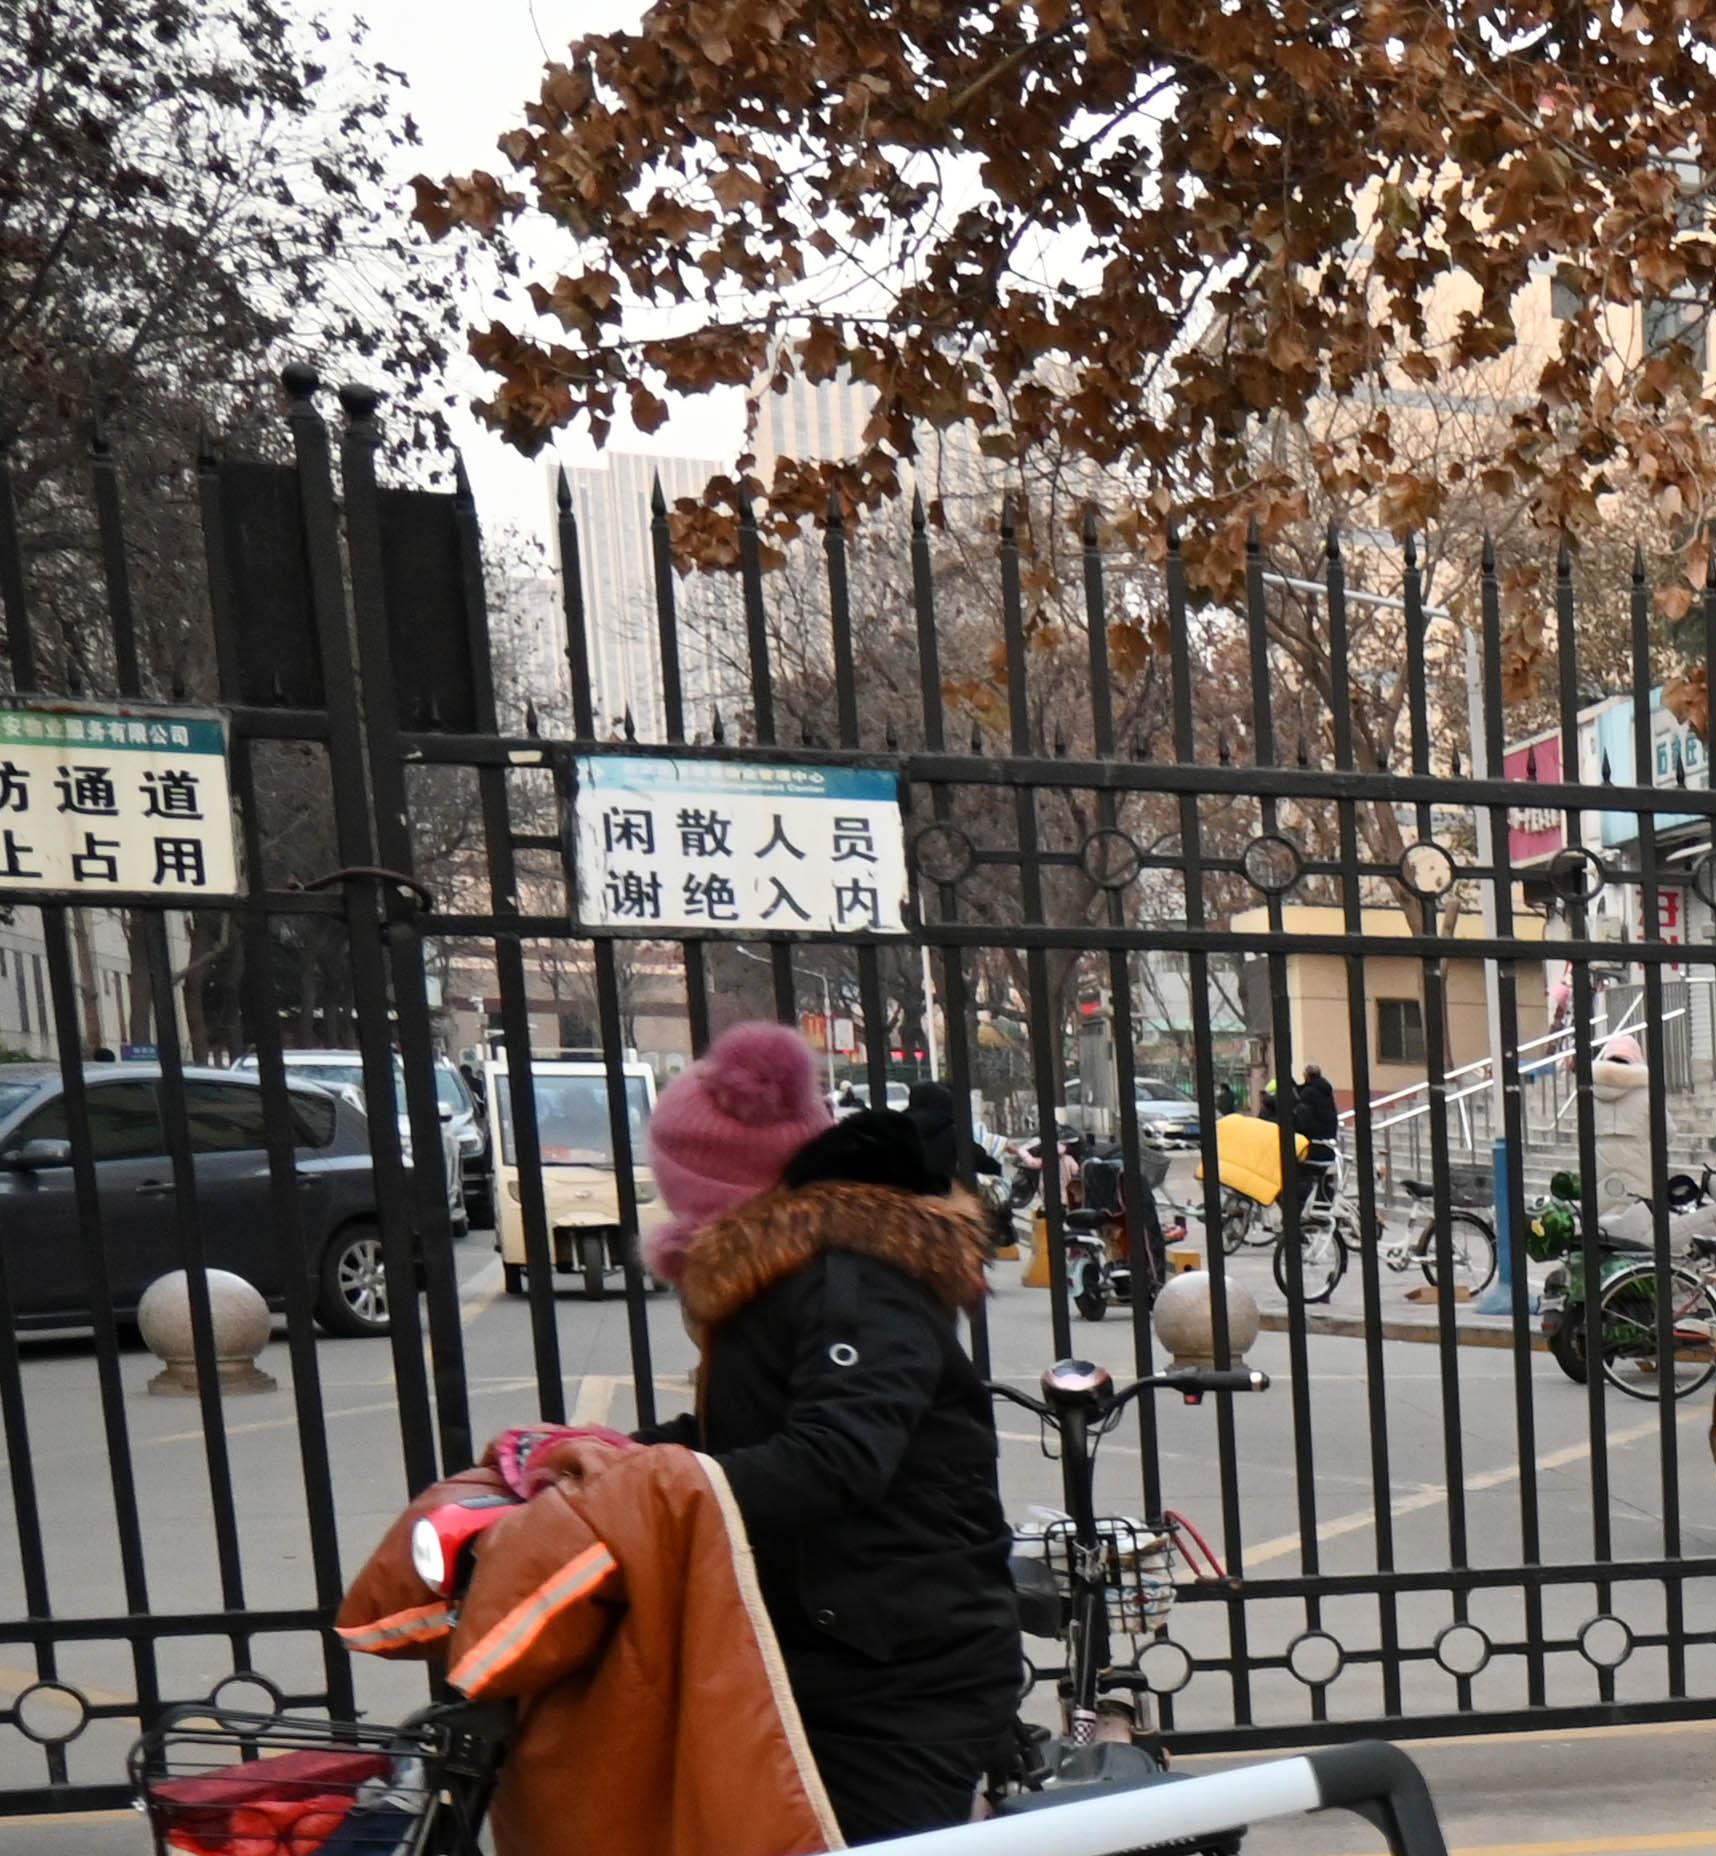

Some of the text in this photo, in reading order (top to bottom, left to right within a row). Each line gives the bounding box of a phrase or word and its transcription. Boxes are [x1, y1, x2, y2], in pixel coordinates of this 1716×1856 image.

[602, 806, 878, 863] 闲散人员
[605, 870, 881, 929] 谢绝入内
